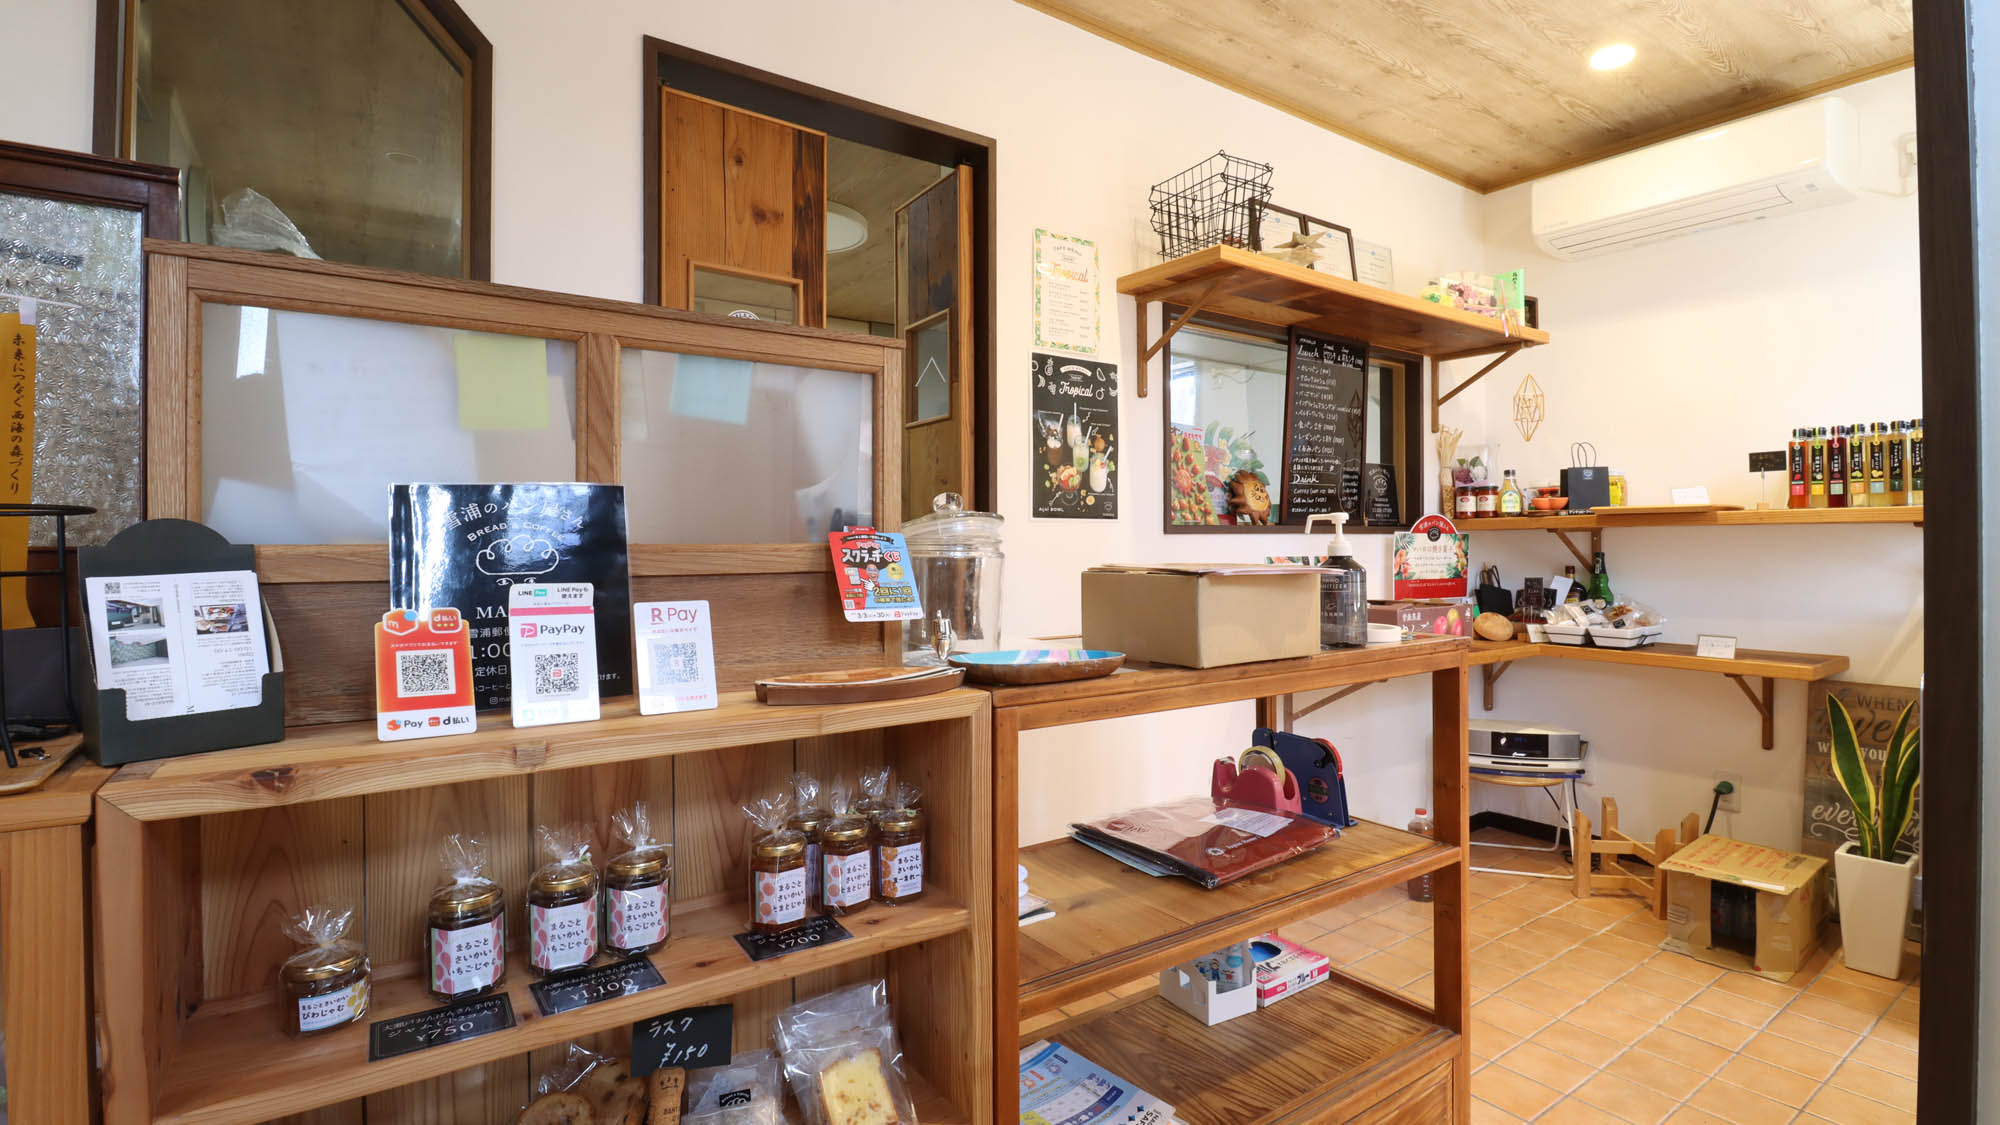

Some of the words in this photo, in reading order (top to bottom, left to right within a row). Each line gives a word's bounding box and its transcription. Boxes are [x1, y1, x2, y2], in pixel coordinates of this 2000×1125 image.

[1059, 380, 1094, 398] Tropical
[1292, 473, 1320, 484] Drink
[466, 522, 508, 542] BREAD
[522, 521, 565, 541] COFFEE
[667, 607, 697, 623] Pay
[540, 623, 585, 636] PayPay
[474, 664, 508, 678] 定休日
[404, 719, 423, 728] Pay
[443, 716, 470, 725] d払い
[1860, 747, 1887, 761] you
[456, 937, 490, 952] まるごと
[455, 949, 493, 965] さいかい
[447, 957, 497, 976] いちごじゃむ
[302, 1004, 345, 1020] びわじゃむ
[416, 1021, 474, 1042] ¥750
[648, 1016, 694, 1039] ラスク
[659, 1042, 709, 1069] ¥150
